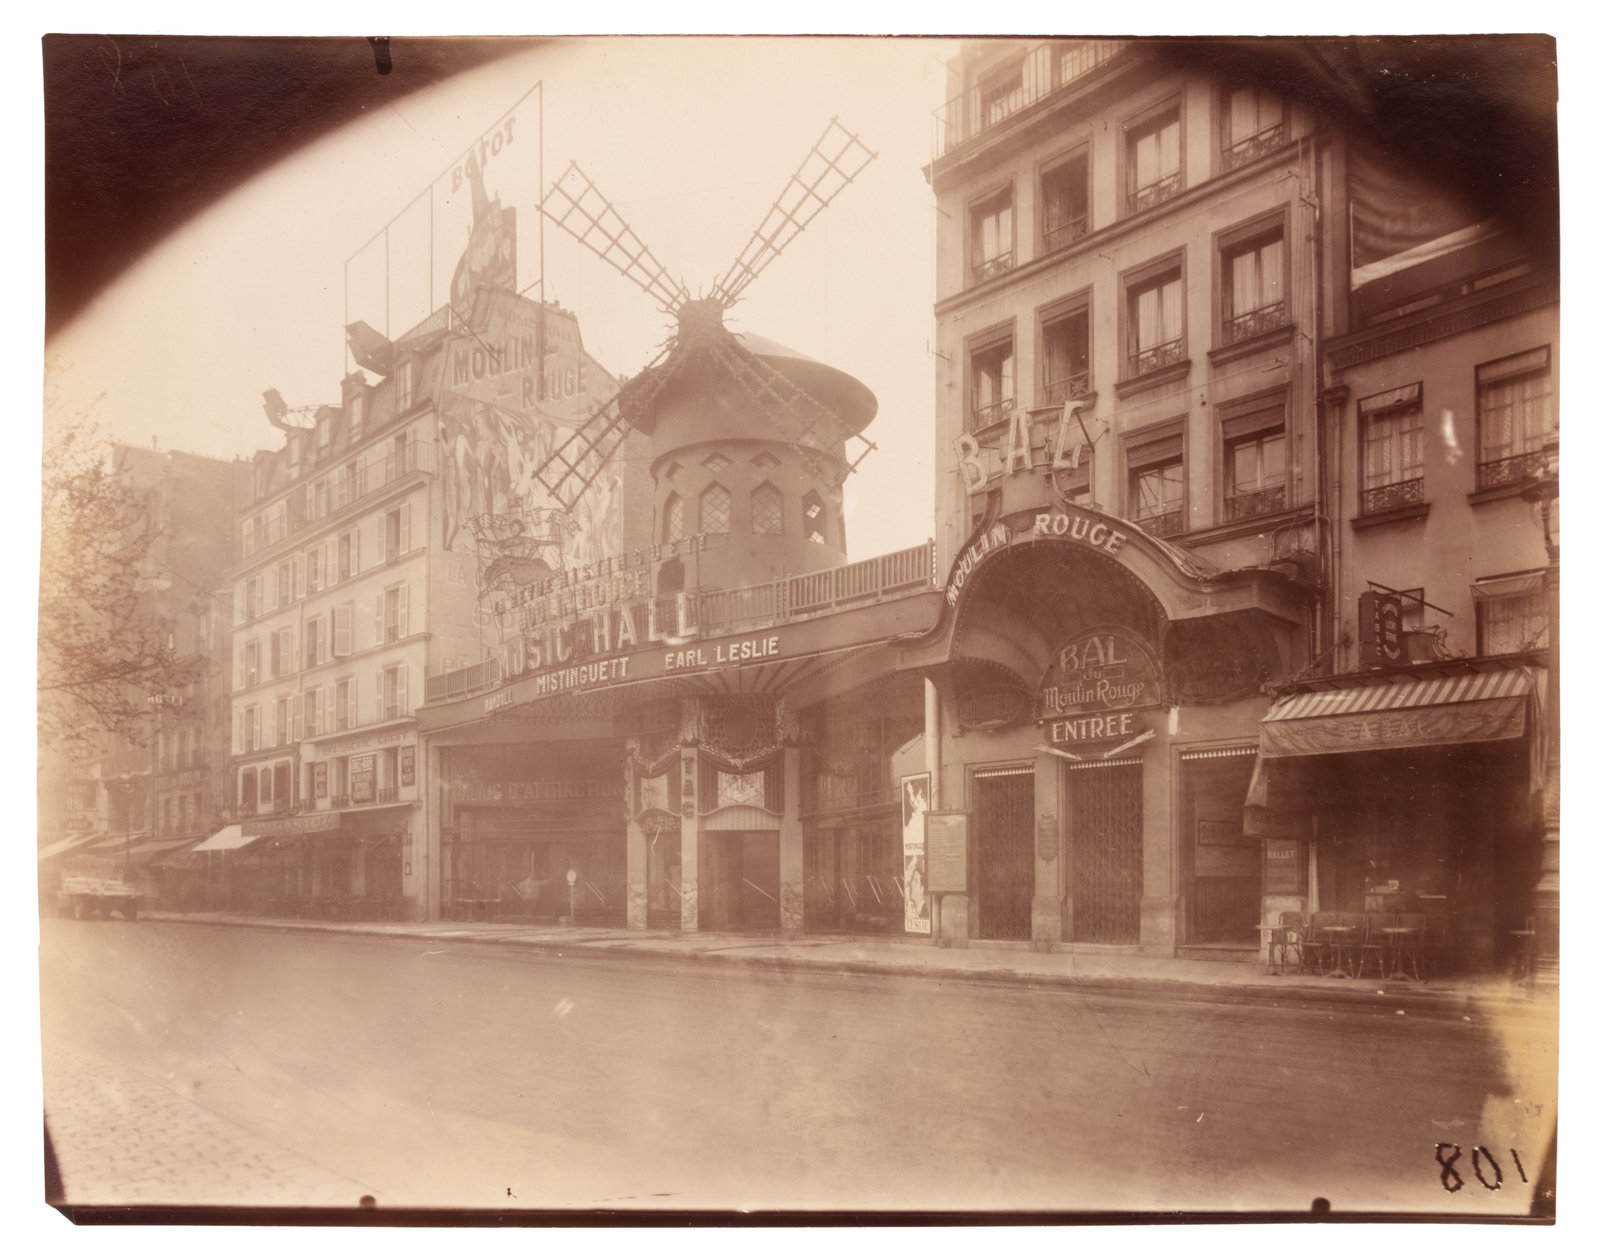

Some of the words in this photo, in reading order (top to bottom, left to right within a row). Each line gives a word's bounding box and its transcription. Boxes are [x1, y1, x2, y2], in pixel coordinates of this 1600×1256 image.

[453, 333, 534, 387] MOULIN
[522, 359, 587, 410] ROUGE
[953, 400, 1086, 497] BAL
[946, 524, 1008, 608] MOULIN
[1034, 513, 1128, 555] ROUGE
[590, 592, 699, 655] HALL
[1373, 599, 1382, 657] TABAC
[536, 656, 630, 695] MISTINGUETT
[664, 648, 708, 671] EARL
[716, 636, 780, 664] LESLIE
[1061, 636, 1128, 672] BAL
[1083, 667, 1102, 680] du
[1043, 683, 1094, 712] Moulin
[1097, 680, 1145, 707] Rouge
[1052, 713, 1134, 743] ENTREE
[1434, 1142, 1529, 1194] 801
